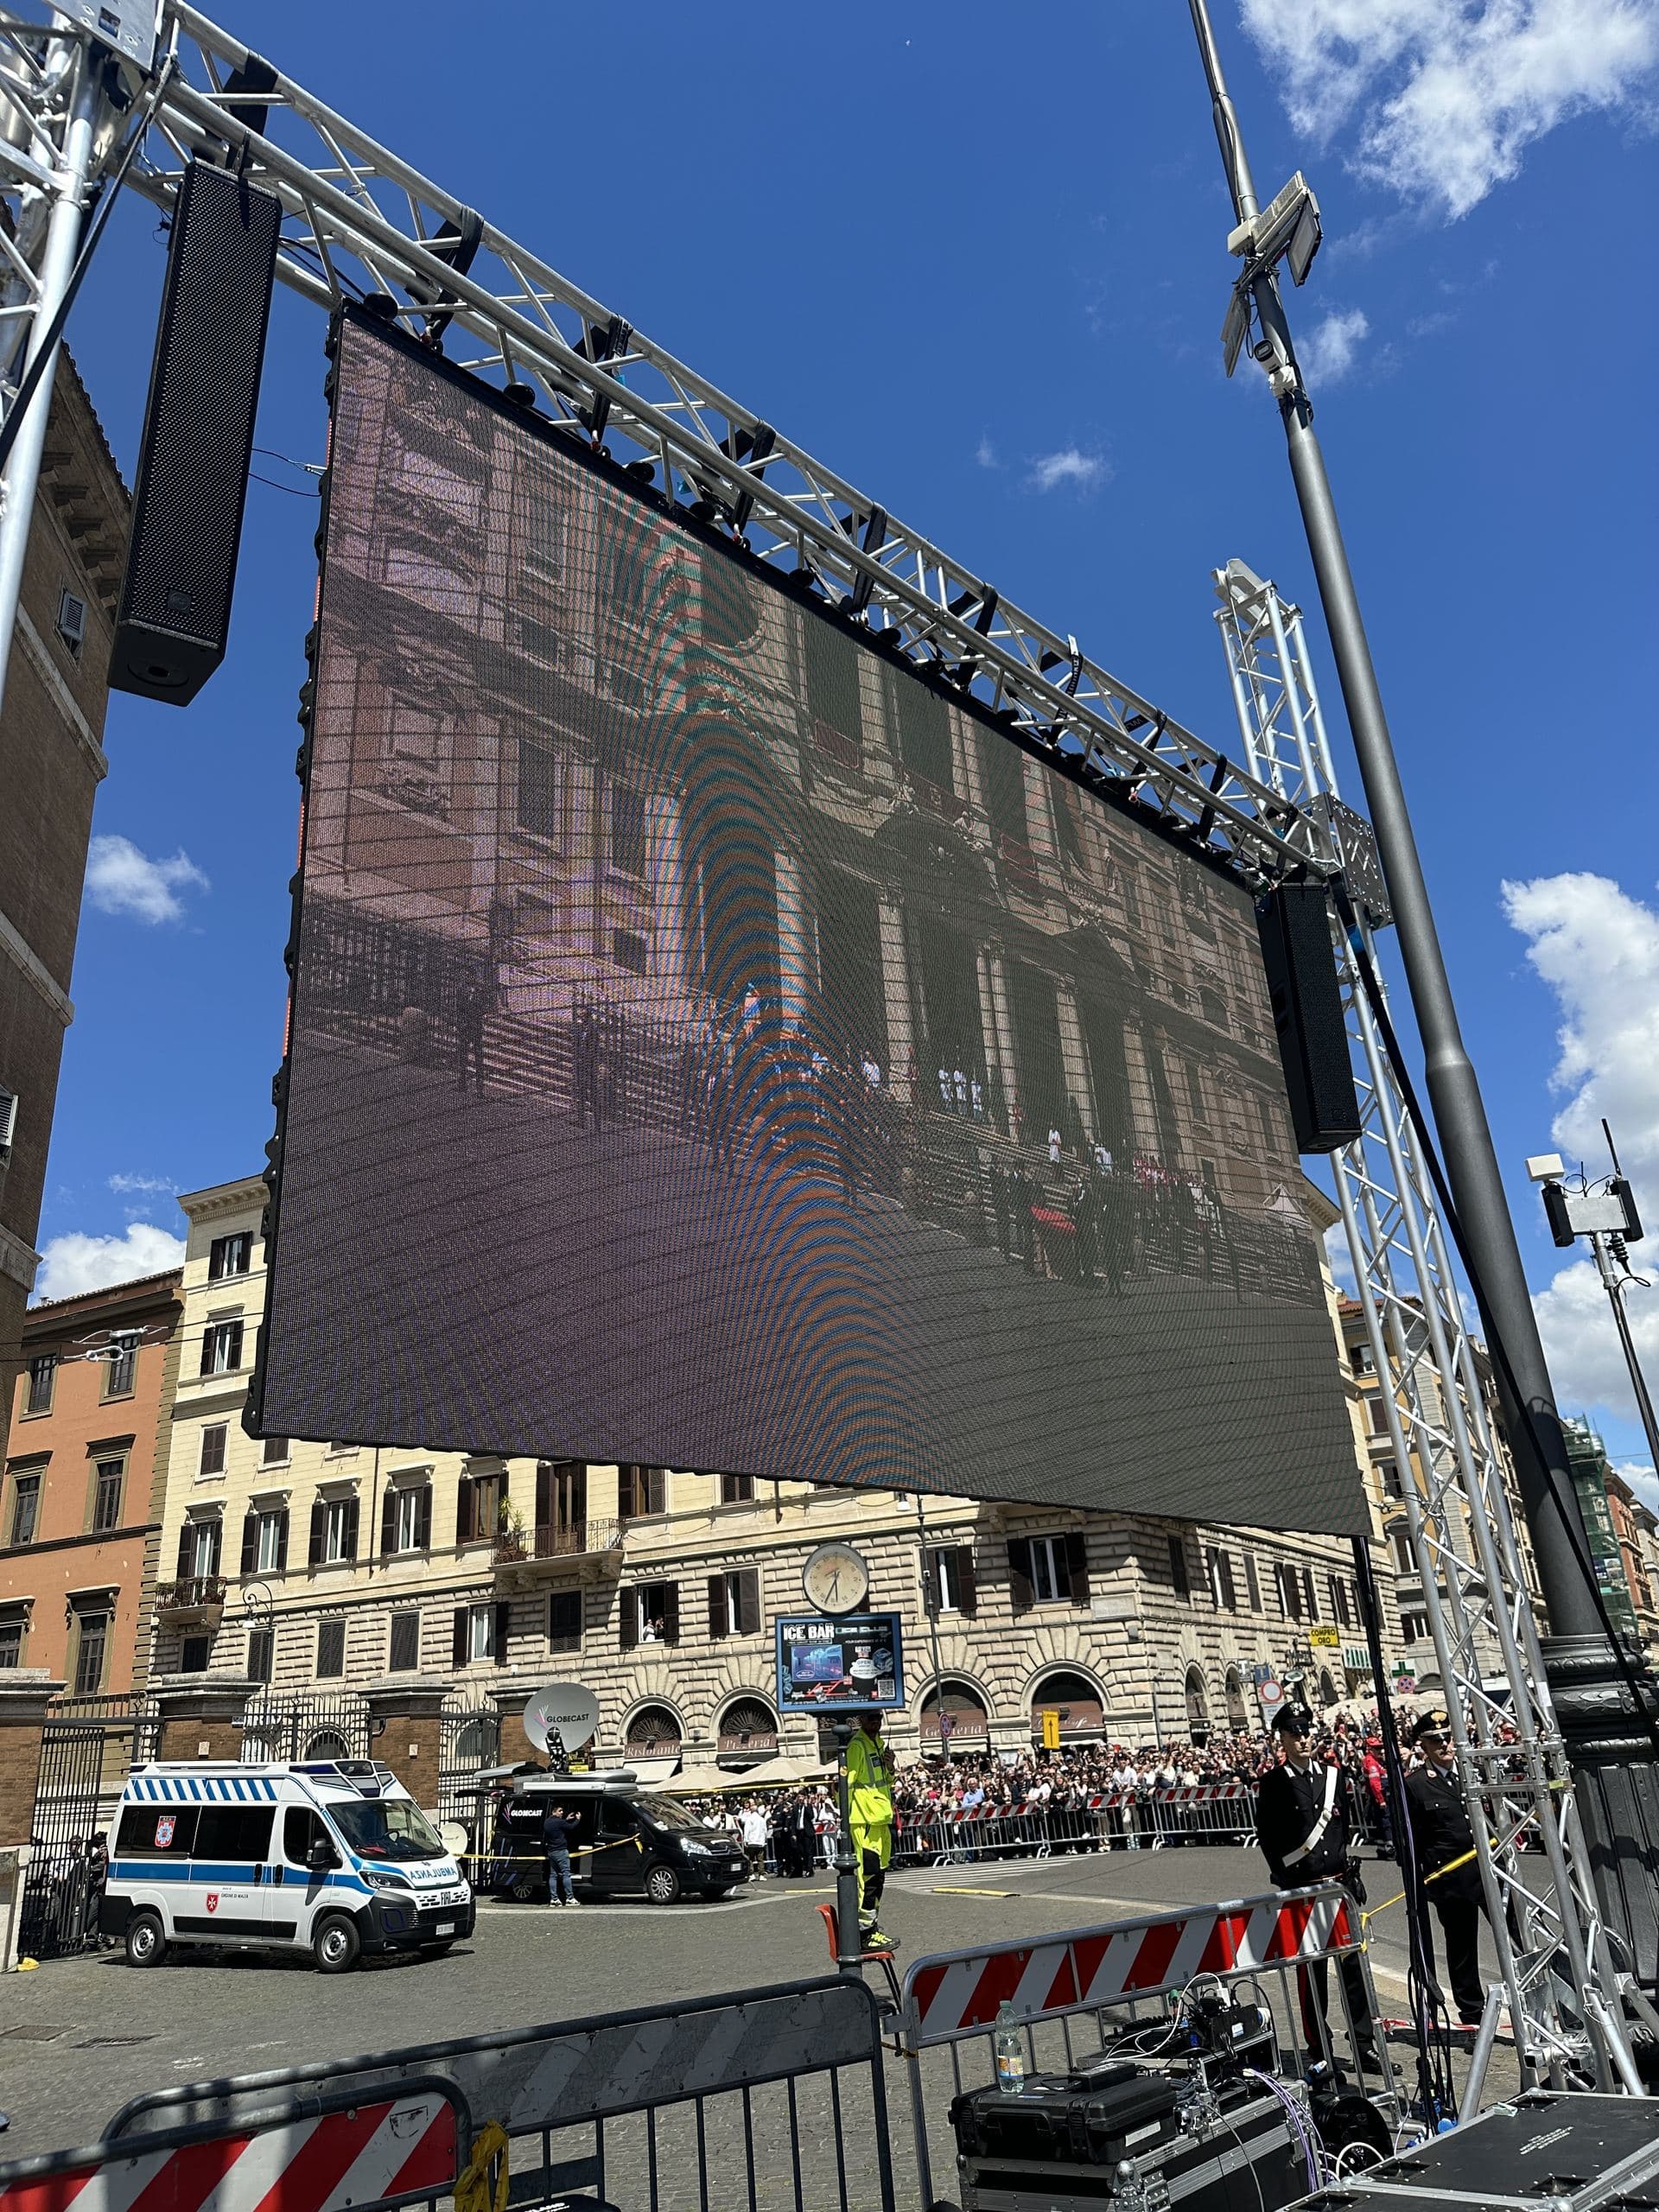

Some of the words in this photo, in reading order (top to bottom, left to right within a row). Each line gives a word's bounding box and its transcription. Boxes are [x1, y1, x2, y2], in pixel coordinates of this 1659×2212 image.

[784, 1624, 806, 1640] ICE
[808, 1623, 835, 1639] BAR
[547, 1713, 589, 1723] GLOBECAST
[925, 1724, 982, 1738] Geteria
[625, 1745, 681, 1757] Ristorante
